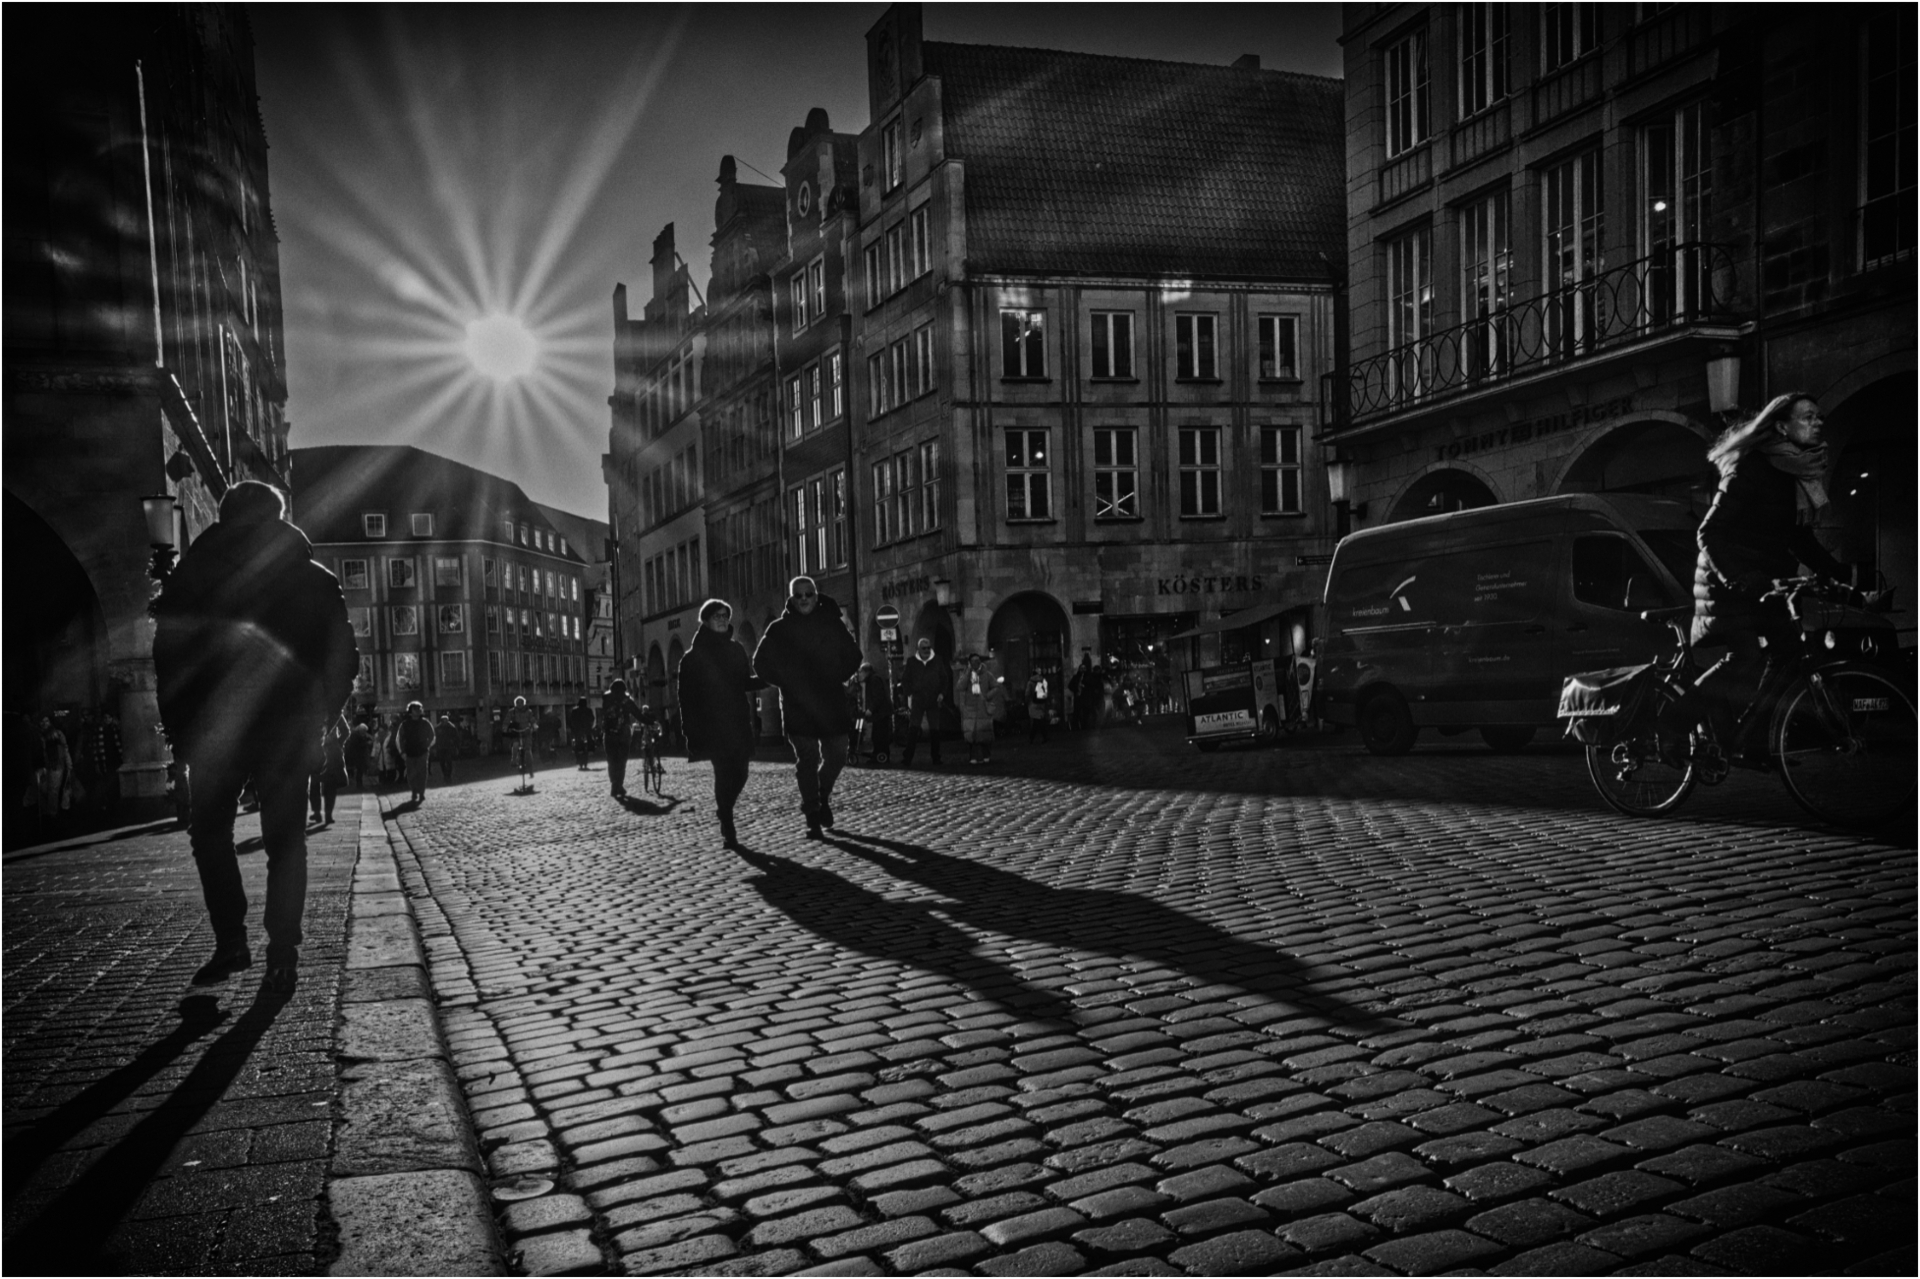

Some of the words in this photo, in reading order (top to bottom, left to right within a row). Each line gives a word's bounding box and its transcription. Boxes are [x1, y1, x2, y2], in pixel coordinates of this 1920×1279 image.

[1436, 429, 1508, 460] TOMMY
[1537, 397, 1634, 434] HILFIGER
[882, 575, 930, 601] KÖSTERS
[1158, 574, 1262, 596] KÖSTERS
[1352, 604, 1390, 617] kreienbaum
[1200, 711, 1244, 724] ATLANTIC
